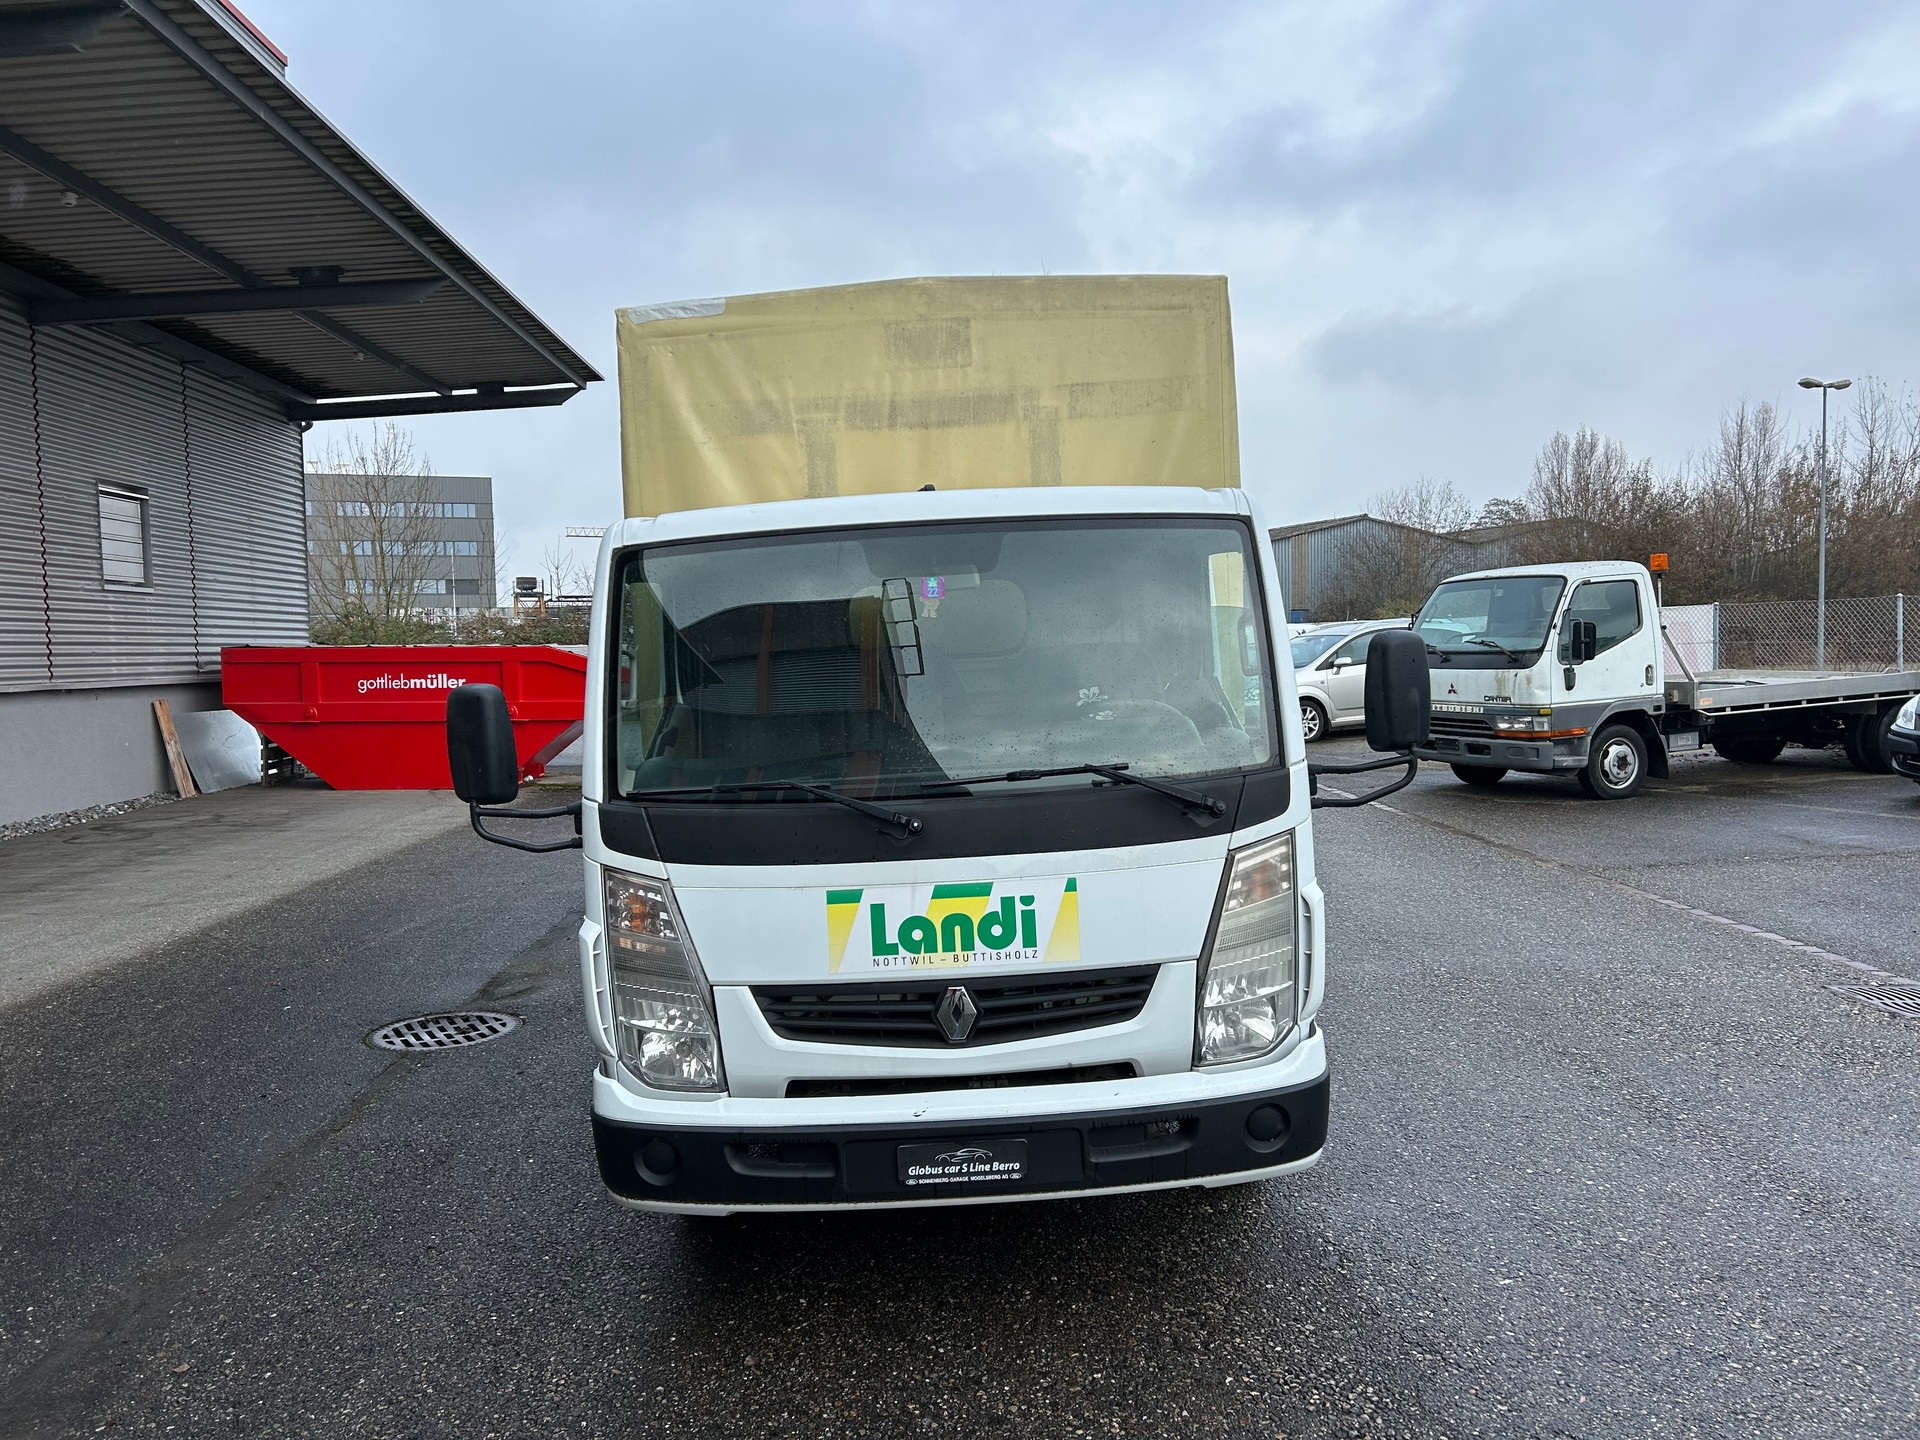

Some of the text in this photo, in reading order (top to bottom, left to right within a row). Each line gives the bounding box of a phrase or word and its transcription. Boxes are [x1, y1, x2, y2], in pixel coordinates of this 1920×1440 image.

[928, 587, 939, 597] 22
[357, 673, 466, 693] gottliebmüller
[1431, 704, 1483, 714] ITSUBISHI
[870, 895, 1038, 956] Landi
[873, 956, 935, 967] NOTTWIL
[953, 949, 1038, 963] BUTTISHOLZ
[908, 1161, 1020, 1176] Globus car S Line Berro
